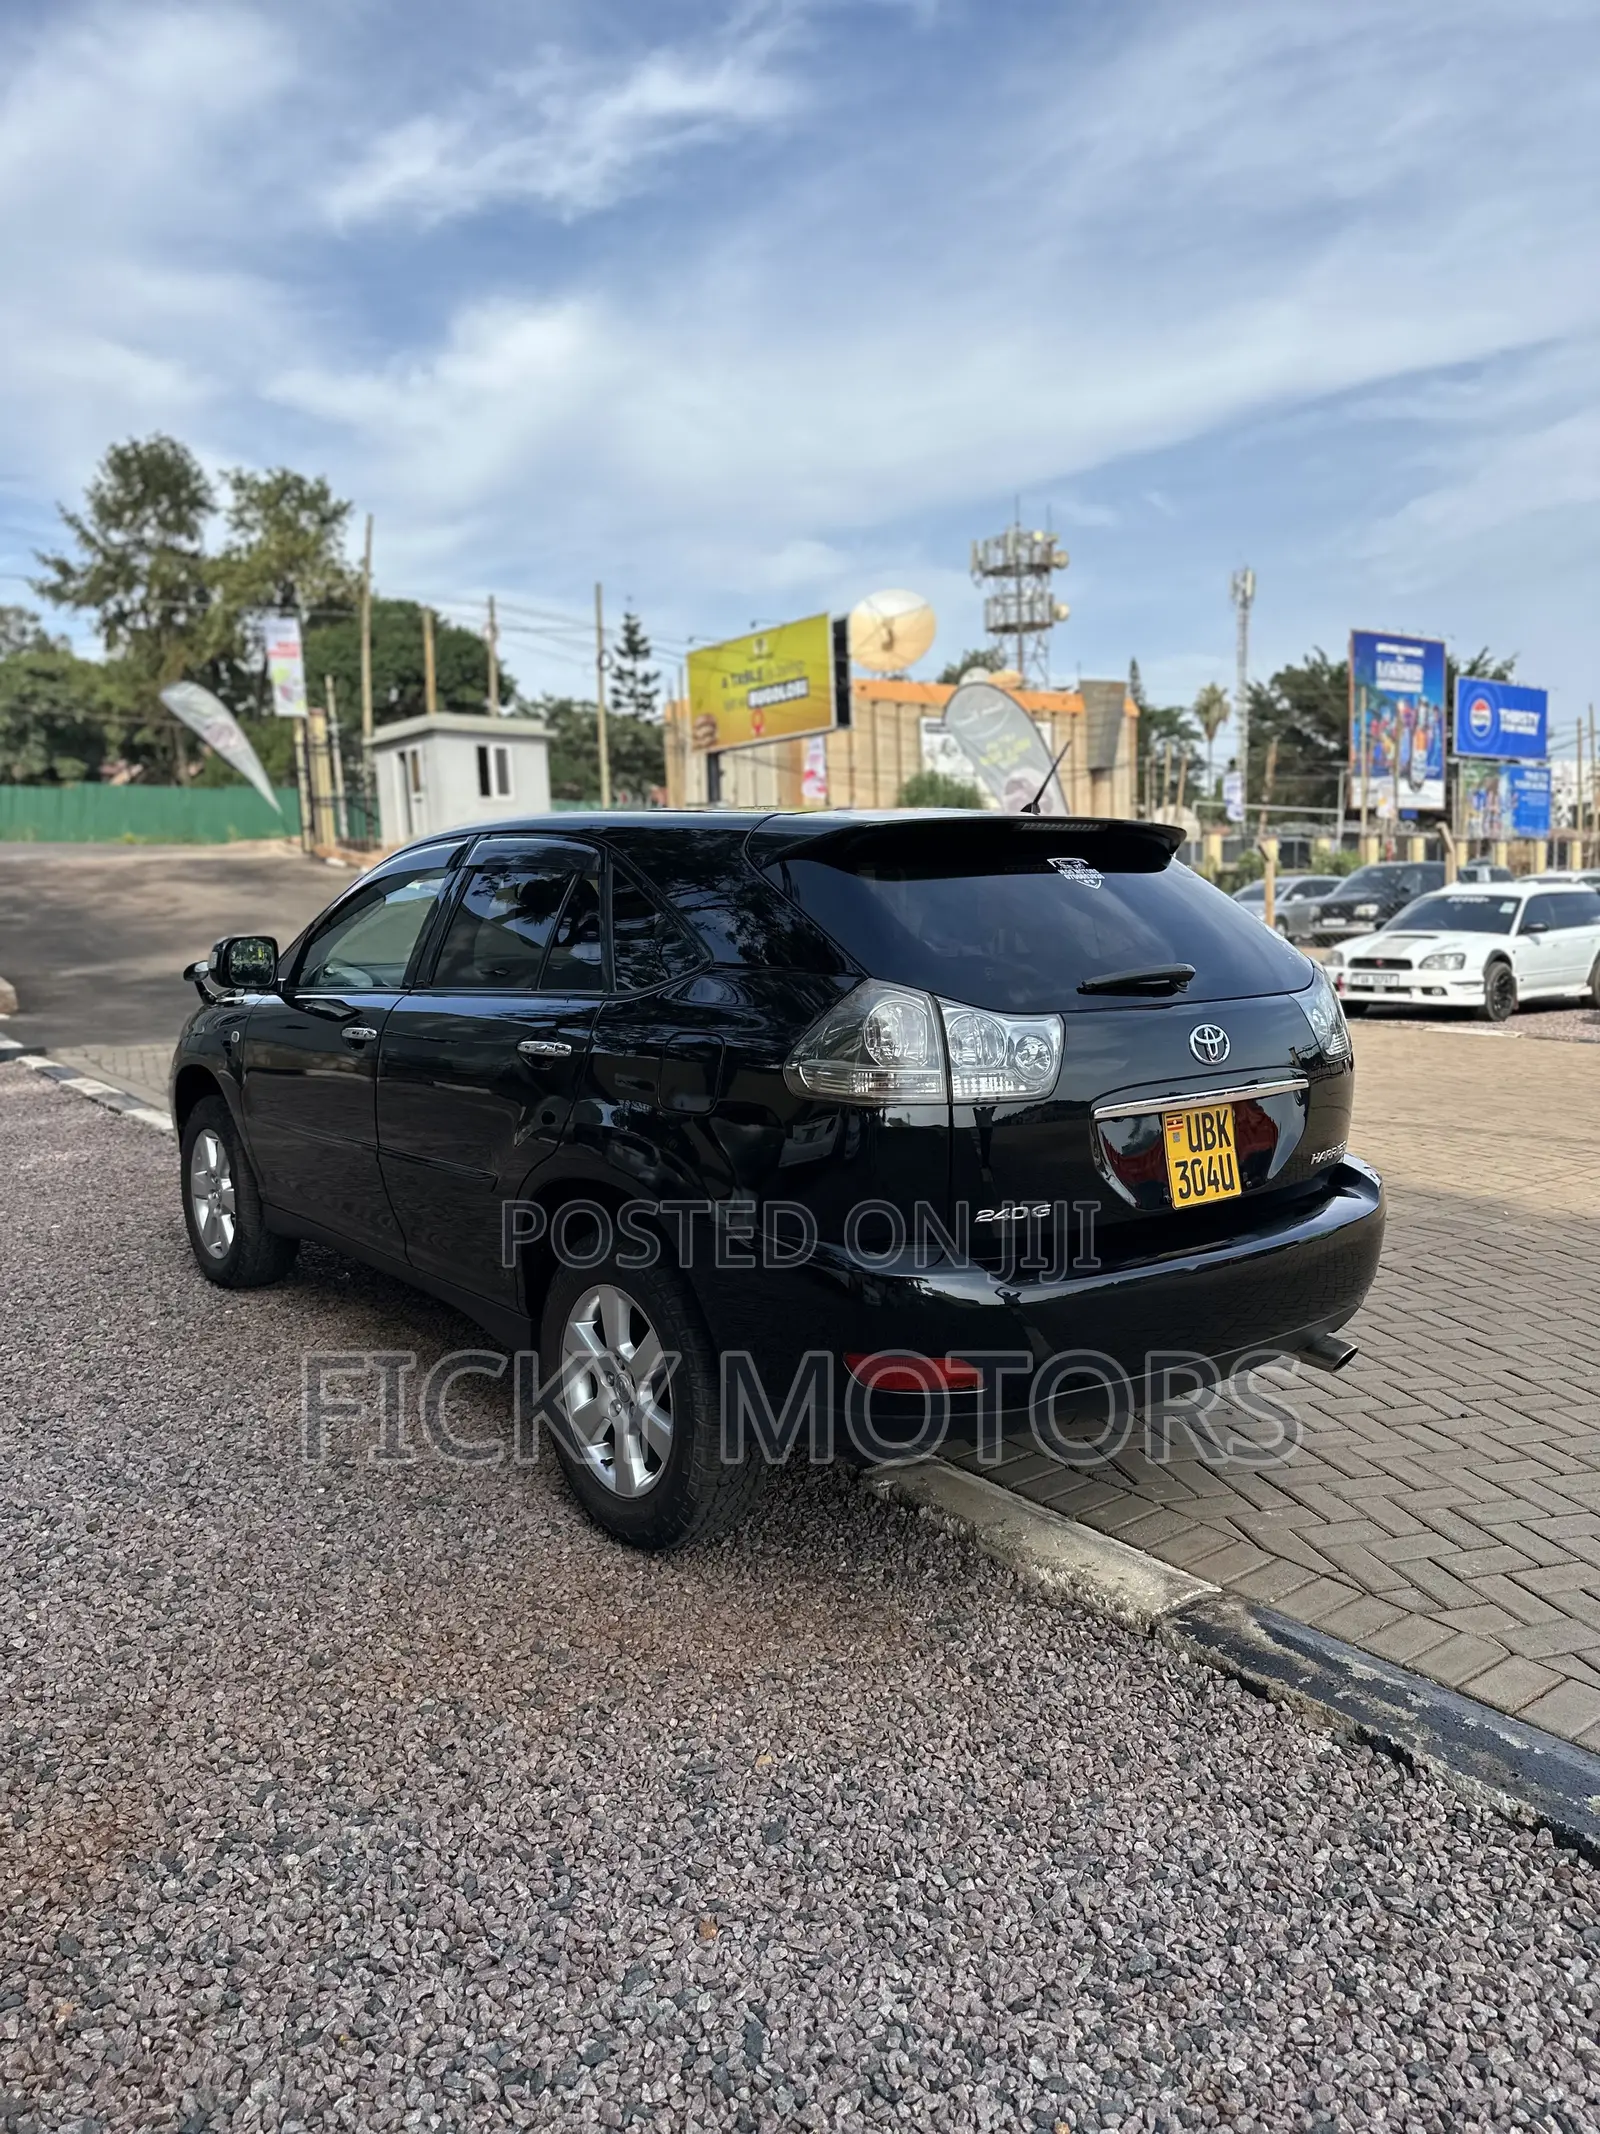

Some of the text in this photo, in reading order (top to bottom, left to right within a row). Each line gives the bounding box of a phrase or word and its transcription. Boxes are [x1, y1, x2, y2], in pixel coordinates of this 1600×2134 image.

[1186, 1110, 1231, 1153] UBK
[1174, 1152, 1236, 1200] 304U
[974, 1204, 1052, 1223] 240G
